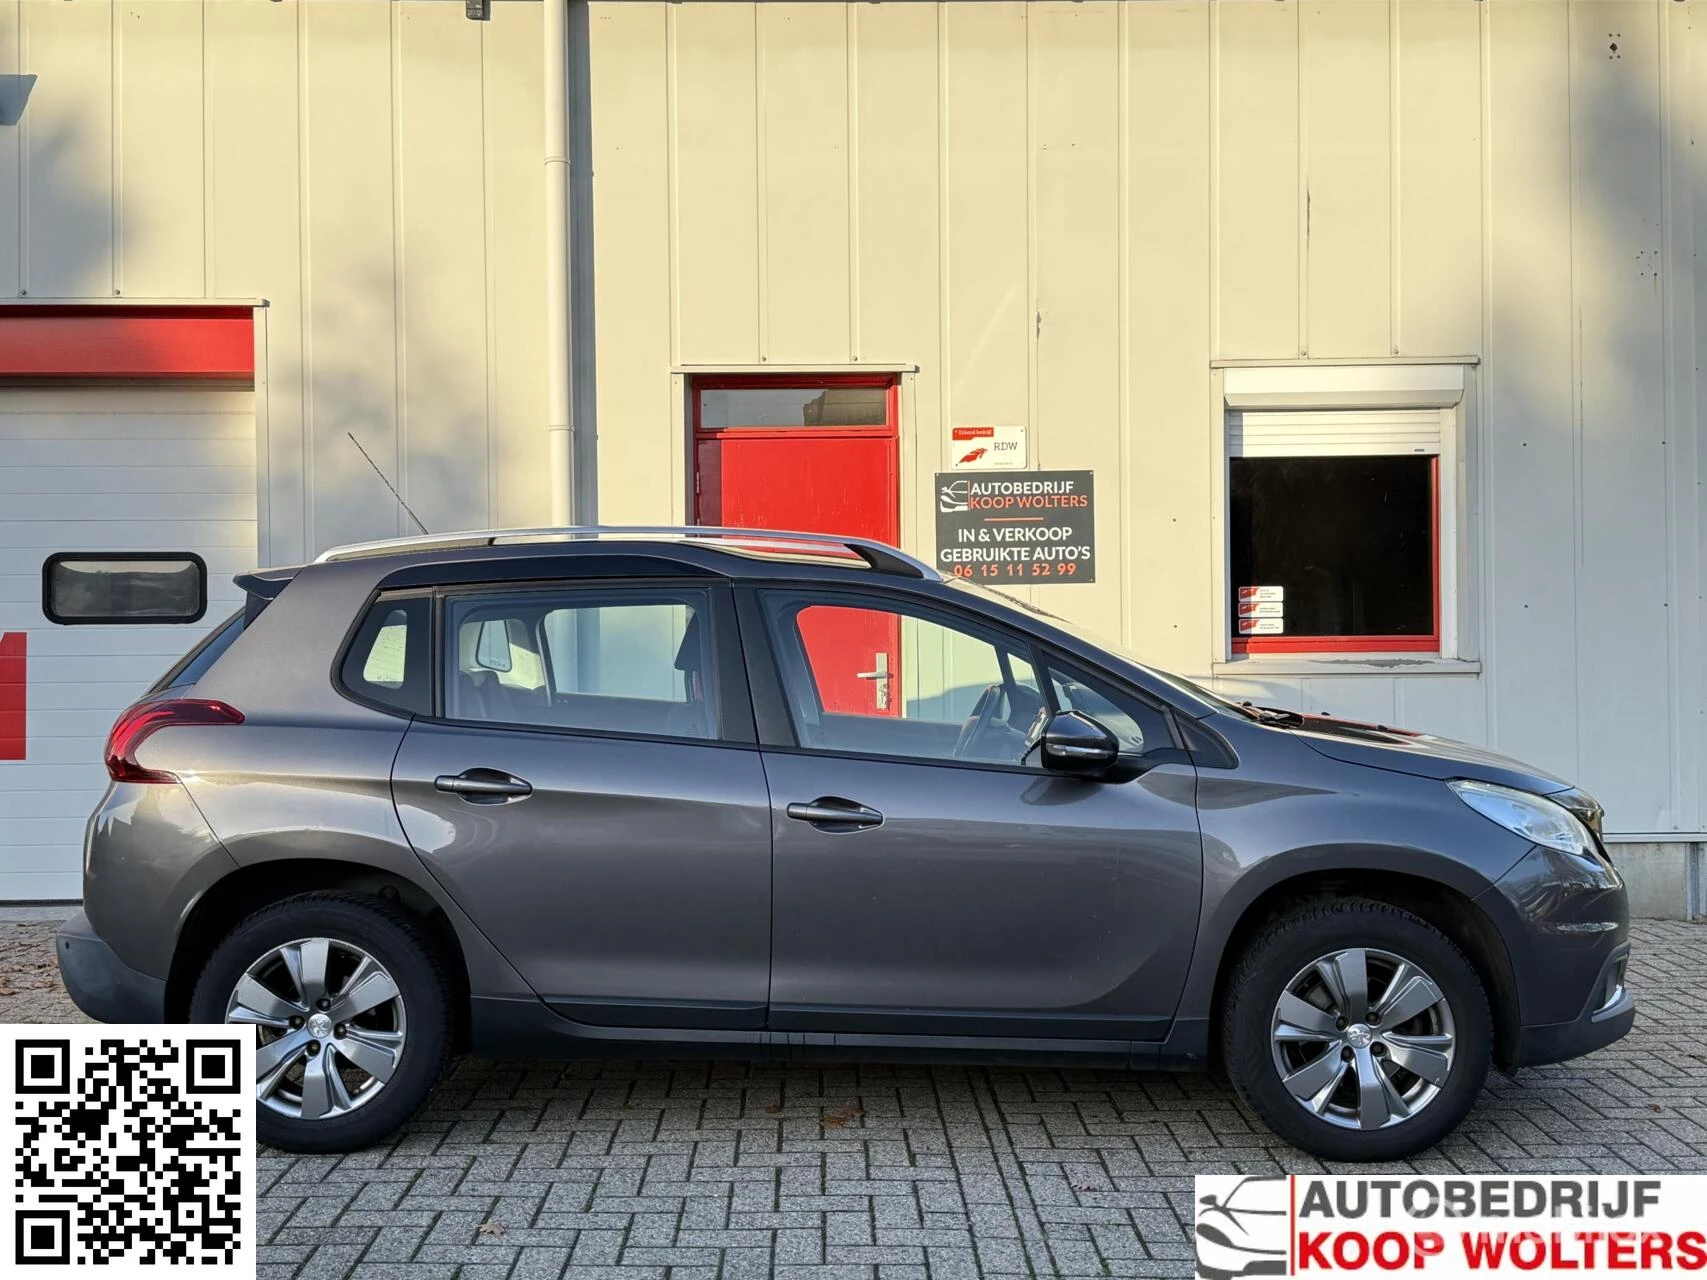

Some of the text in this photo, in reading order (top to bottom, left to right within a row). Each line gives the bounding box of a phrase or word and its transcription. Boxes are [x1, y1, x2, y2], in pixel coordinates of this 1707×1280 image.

[994, 442, 1018, 451] RDW
[971, 481, 1074, 495] AUTOBEDRIJF
[971, 495, 1088, 509] KOOP WOLTERS
[958, 527, 1073, 542] IN & VERKOOP
[941, 546, 1091, 562] GEBRUIKTE AUTO'S
[954, 563, 1077, 577] 06 15 11 52 99
